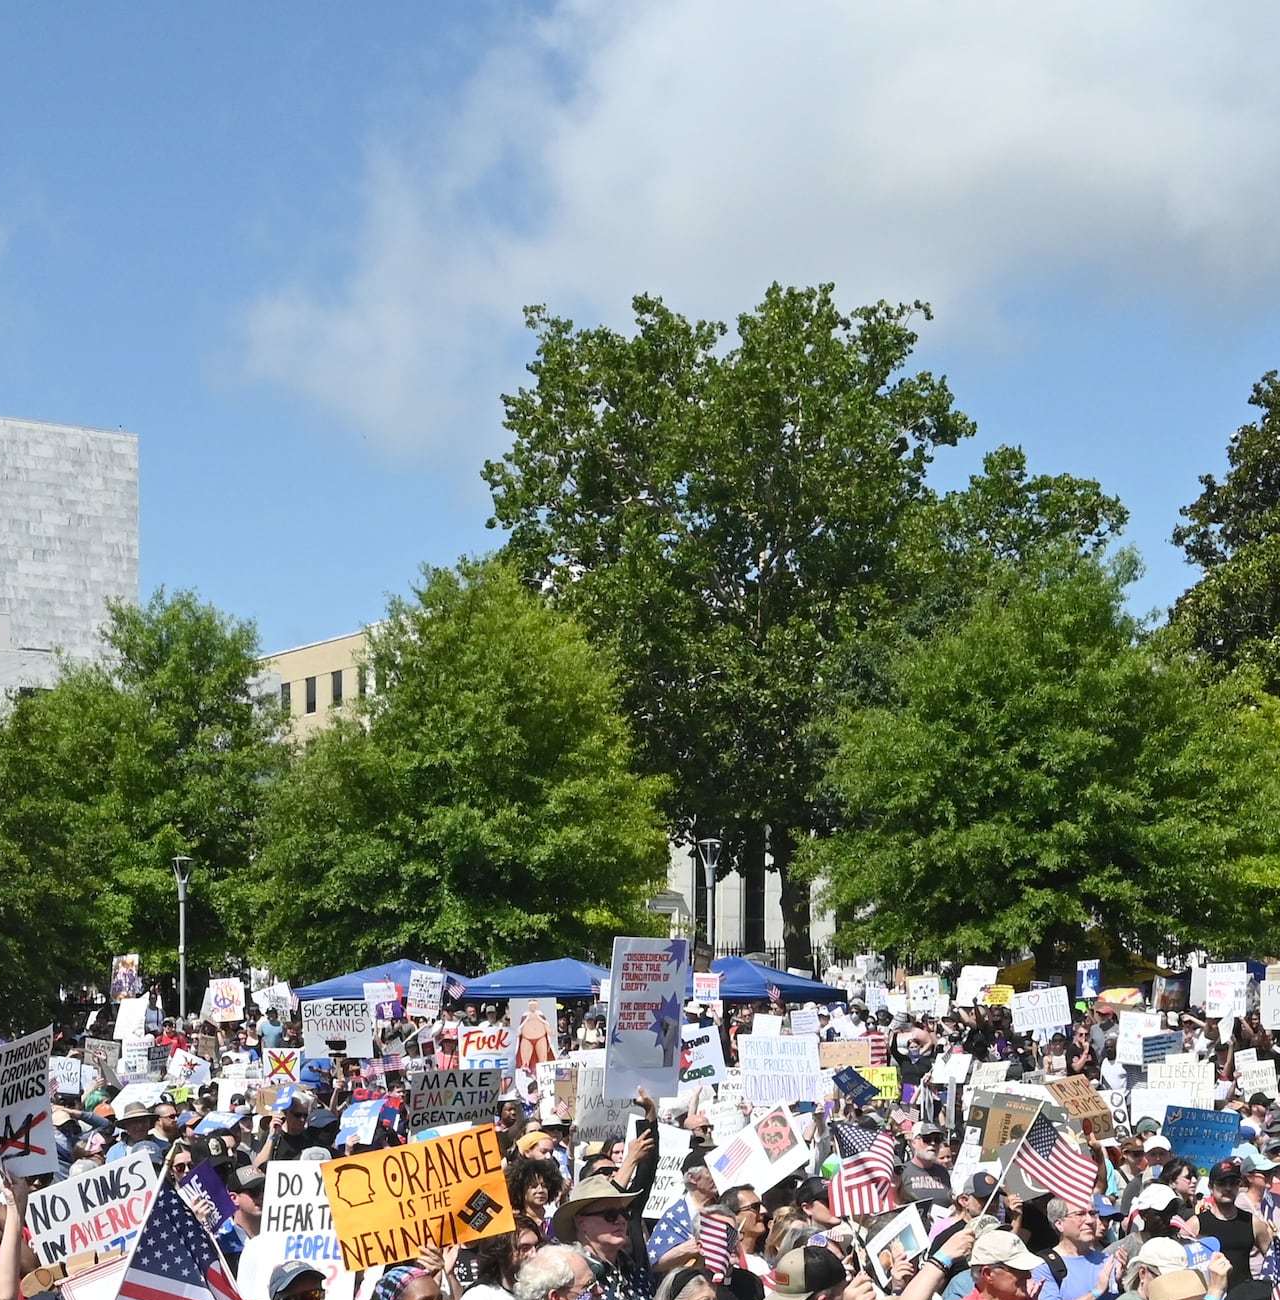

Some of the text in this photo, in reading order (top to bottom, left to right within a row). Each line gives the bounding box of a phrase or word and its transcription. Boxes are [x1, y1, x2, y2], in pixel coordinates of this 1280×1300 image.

[631, 963, 661, 971] THE TRUE
[304, 1003, 369, 1017] SIC SEMPER
[619, 1012, 636, 1020] MUST
[620, 1002, 632, 1010] THE
[304, 1018, 365, 1032] TYRANNIS
[4, 1034, 51, 1067] THRONES
[744, 1040, 773, 1055] PRISON
[775, 1041, 808, 1054] WITHOUT
[1, 1055, 48, 1084] CROWNS
[763, 1058, 793, 1071] PROCESS
[1, 1074, 45, 1107] KINGS
[420, 1072, 491, 1090] MAKE
[413, 1090, 500, 1111] EMPATHY
[411, 1110, 497, 1127] GREAT AGAIN
[383, 1135, 503, 1198] ORANGE
[278, 1172, 303, 1198] DO
[29, 1160, 147, 1235] NO KINGS
[398, 1188, 452, 1217] IS THE
[267, 1203, 314, 1232] HEAR
[285, 1235, 341, 1260] PEOPLE
[340, 1213, 458, 1271] NEW NAZI
